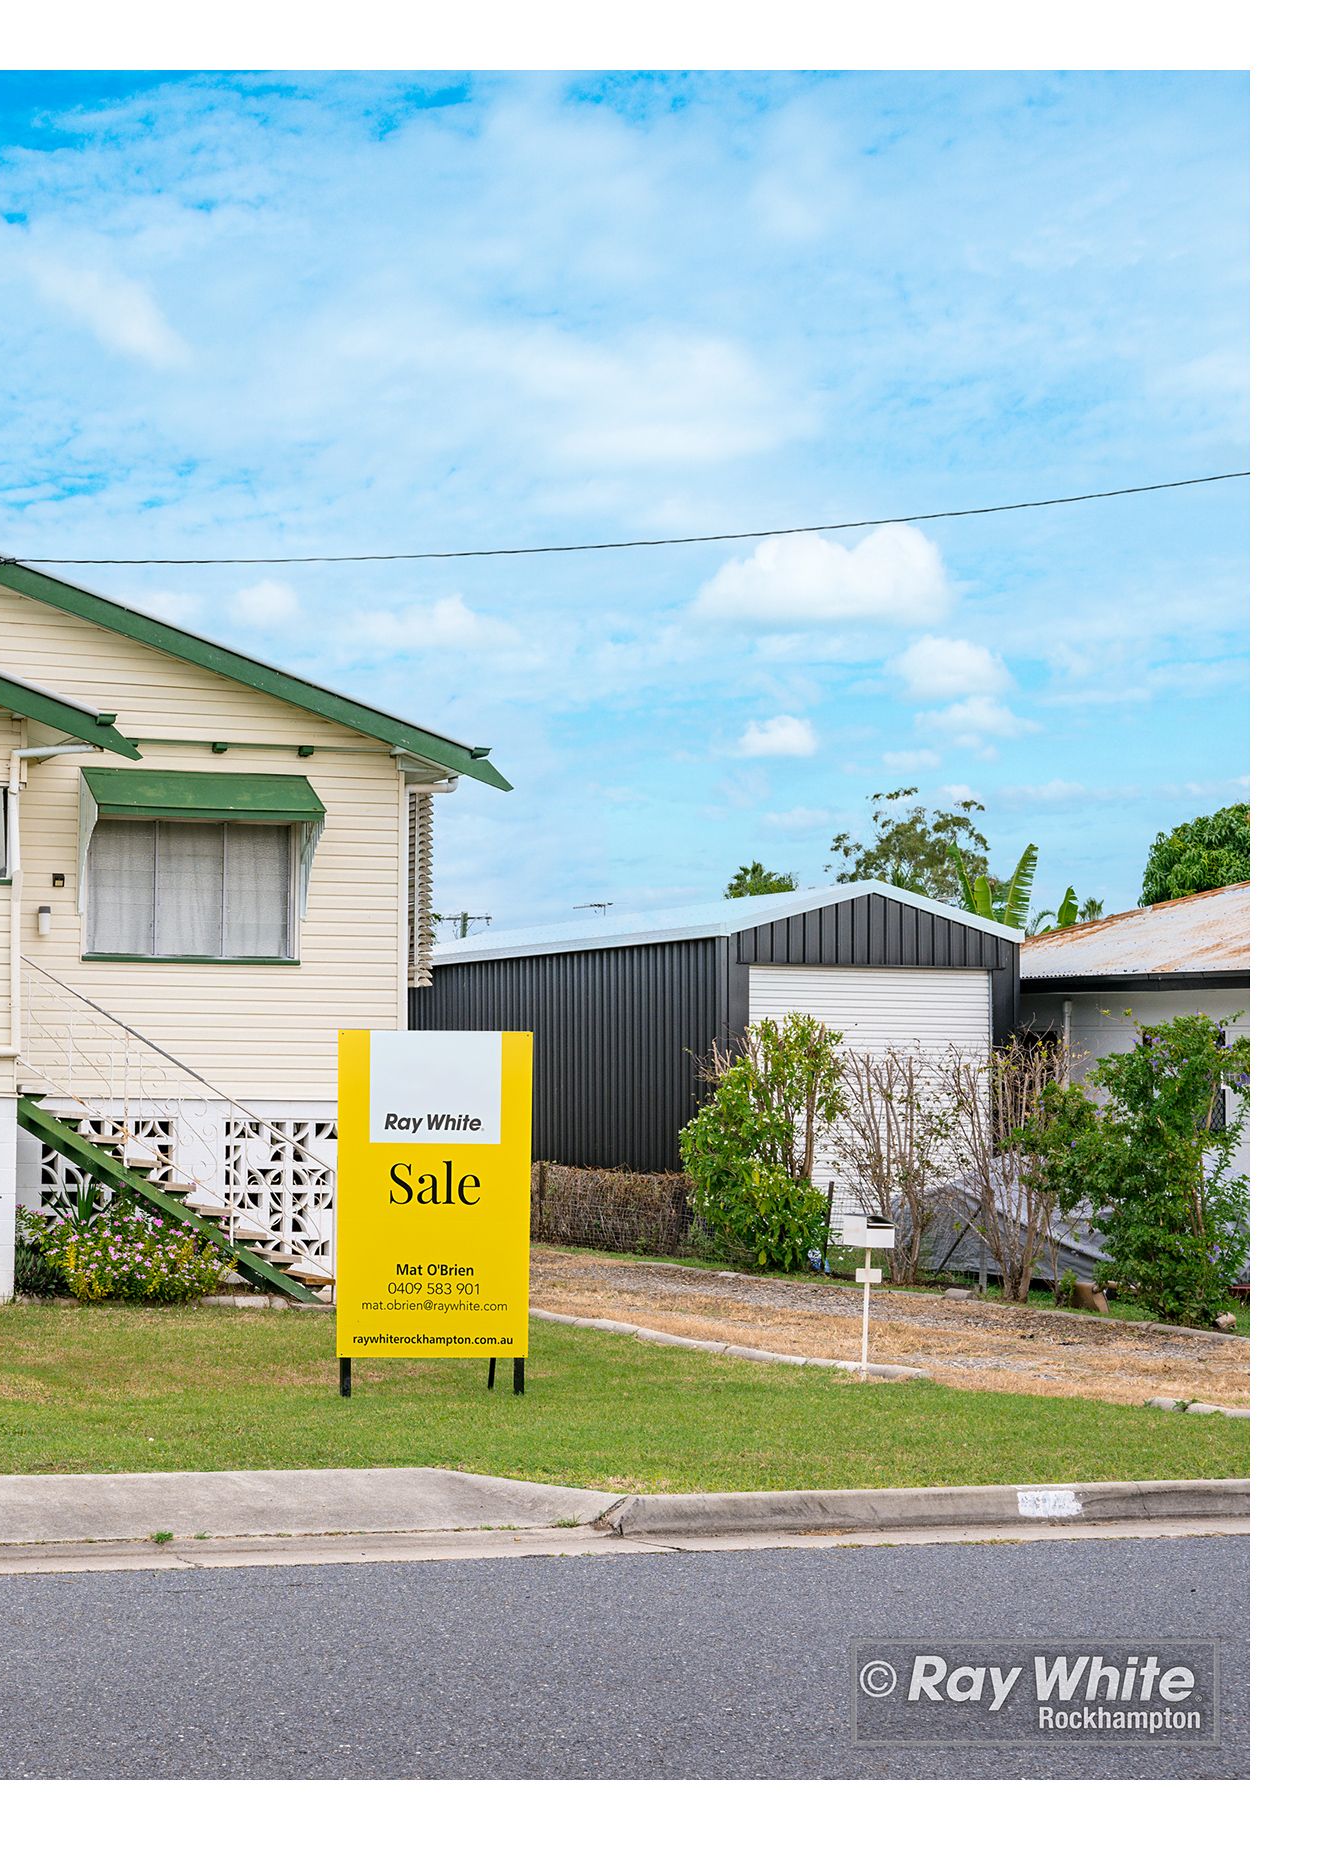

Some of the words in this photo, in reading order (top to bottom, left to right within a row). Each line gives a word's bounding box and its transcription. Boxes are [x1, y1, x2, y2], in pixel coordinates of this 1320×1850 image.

[384, 1113, 424, 1134] Ray
[426, 1113, 482, 1131] White
[389, 1160, 481, 1206] Sale
[396, 1263, 423, 1276] Mat
[426, 1263, 474, 1277] O'Brien
[387, 1282, 423, 1295] 0409
[426, 1282, 452, 1295] 583
[456, 1282, 480, 1295] 901
[361, 1299, 508, 1314] mat.obrien@raywhite.com
[352, 1333, 514, 1347] raywhiterockhampton.com.au
